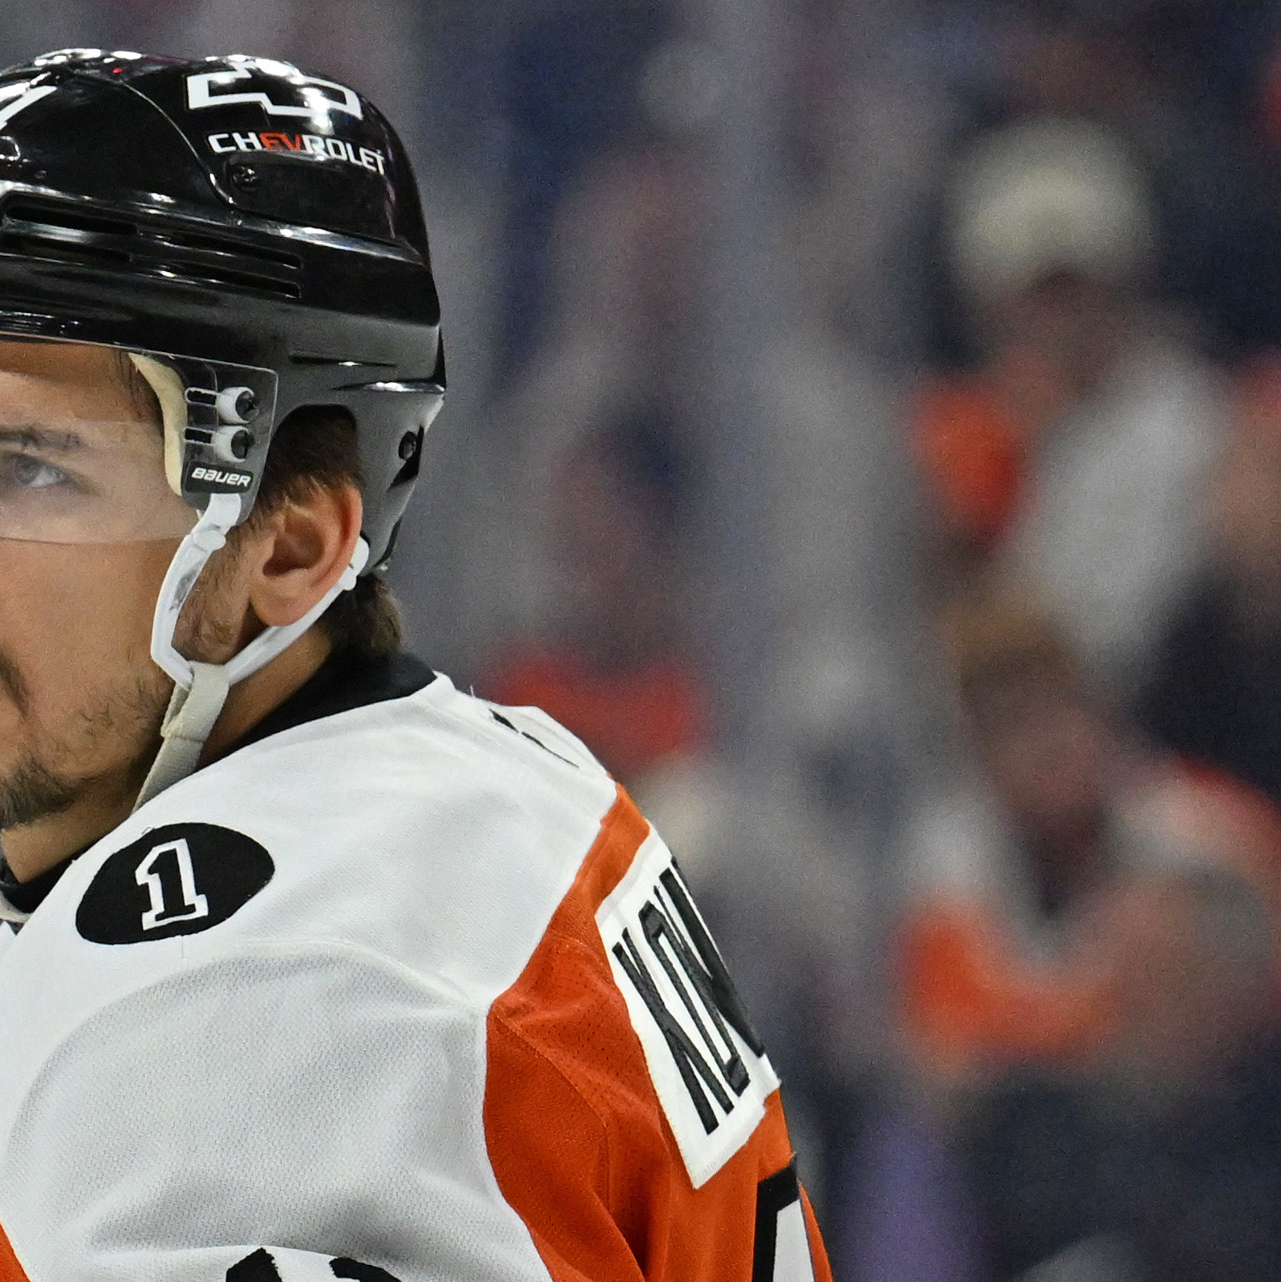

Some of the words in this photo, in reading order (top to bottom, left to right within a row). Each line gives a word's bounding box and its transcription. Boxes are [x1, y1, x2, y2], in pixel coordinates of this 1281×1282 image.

[208, 131, 386, 176] CHEVROLET
[191, 467, 252, 488] BAUER
[135, 838, 209, 930] 1
